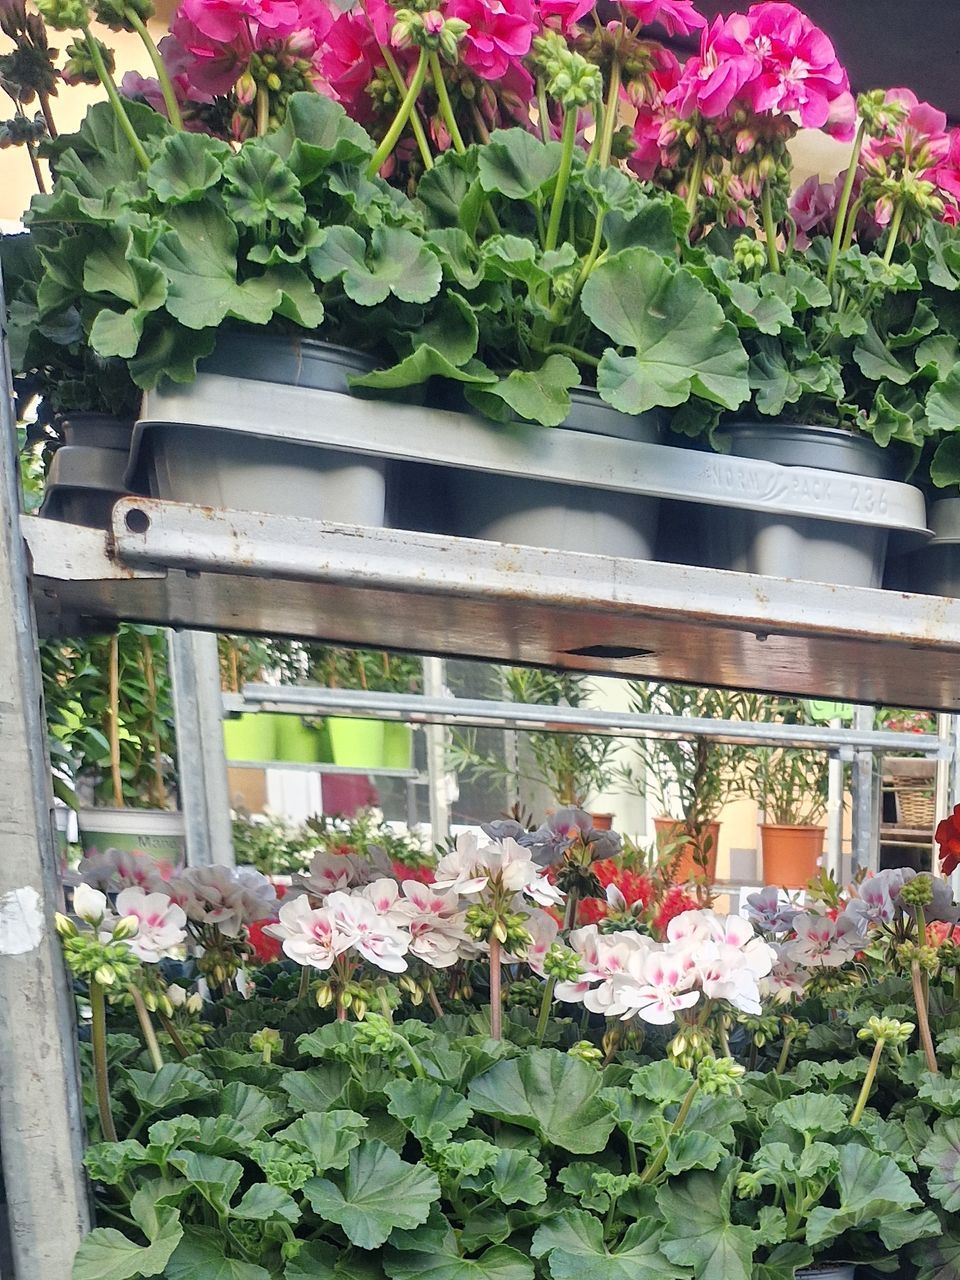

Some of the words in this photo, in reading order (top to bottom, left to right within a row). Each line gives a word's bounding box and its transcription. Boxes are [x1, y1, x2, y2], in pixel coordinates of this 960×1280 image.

[711, 463, 760, 493] NORM
[791, 476, 832, 502] PACK
[849, 483, 889, 515] 236
